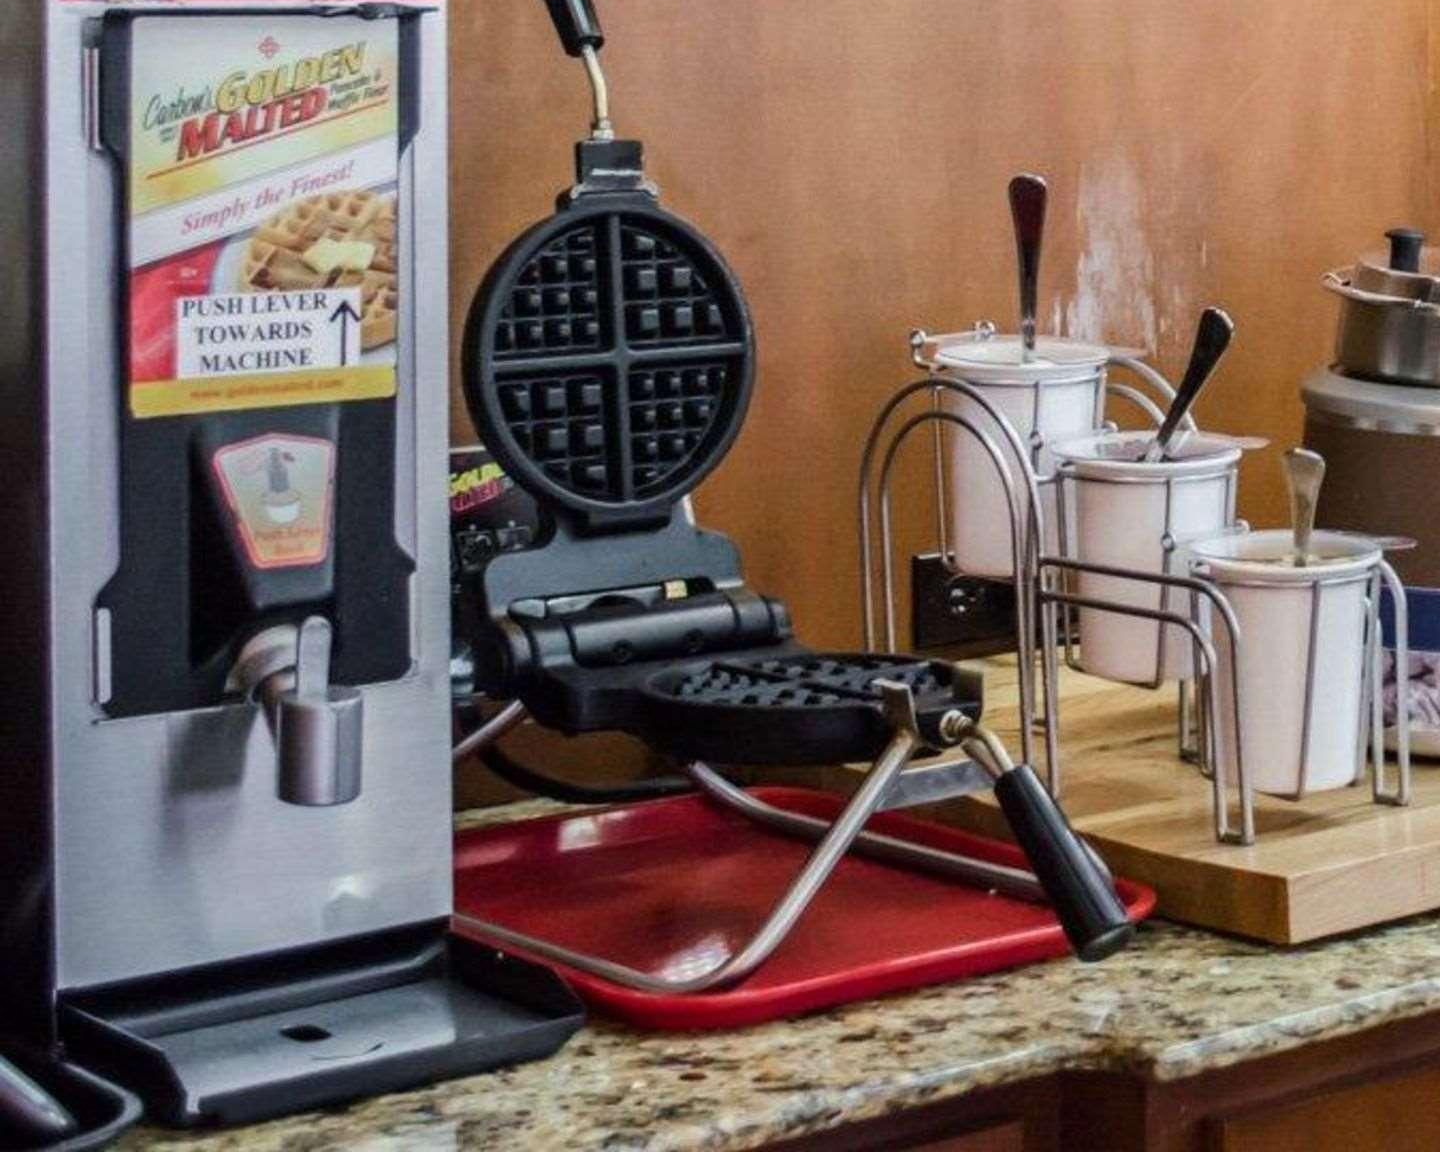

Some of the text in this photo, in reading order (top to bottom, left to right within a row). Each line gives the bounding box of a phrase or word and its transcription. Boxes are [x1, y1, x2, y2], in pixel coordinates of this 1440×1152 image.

[215, 41, 366, 115] GOLDEN
[177, 87, 329, 160] MALTED
[181, 160, 354, 234] Simply the Finest!
[183, 293, 328, 317] PUSH LEVER
[194, 322, 312, 344] TOWARDS
[200, 348, 313, 372] MACHINE
